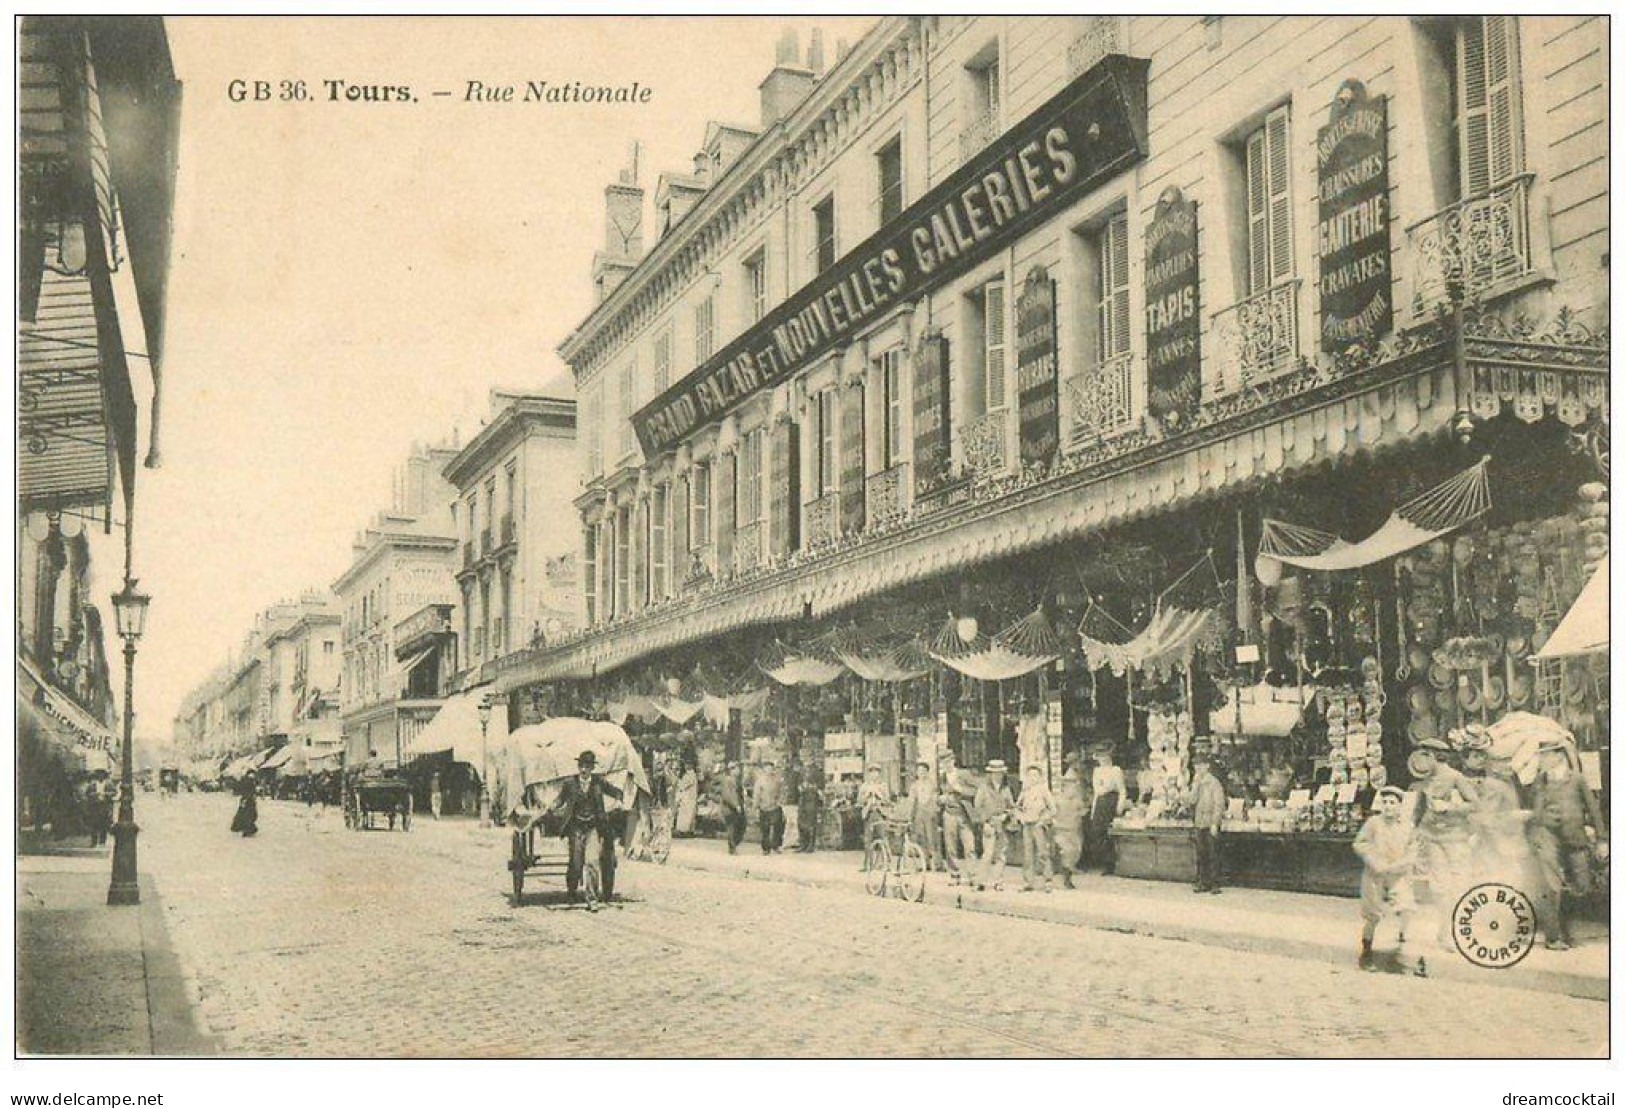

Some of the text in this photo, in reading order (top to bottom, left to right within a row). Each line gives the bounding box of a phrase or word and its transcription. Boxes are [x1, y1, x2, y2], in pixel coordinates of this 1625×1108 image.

[1320, 193, 1384, 257] GANTERIE
[646, 394, 698, 447] GRAND
[695, 352, 758, 417] BAZAR
[756, 345, 776, 380] ET
[773, 248, 907, 366] NOUVELLES
[912, 127, 1077, 274] GALERIES
[1321, 250, 1385, 296] CRAVATES
[1147, 284, 1194, 334] TAPIS
